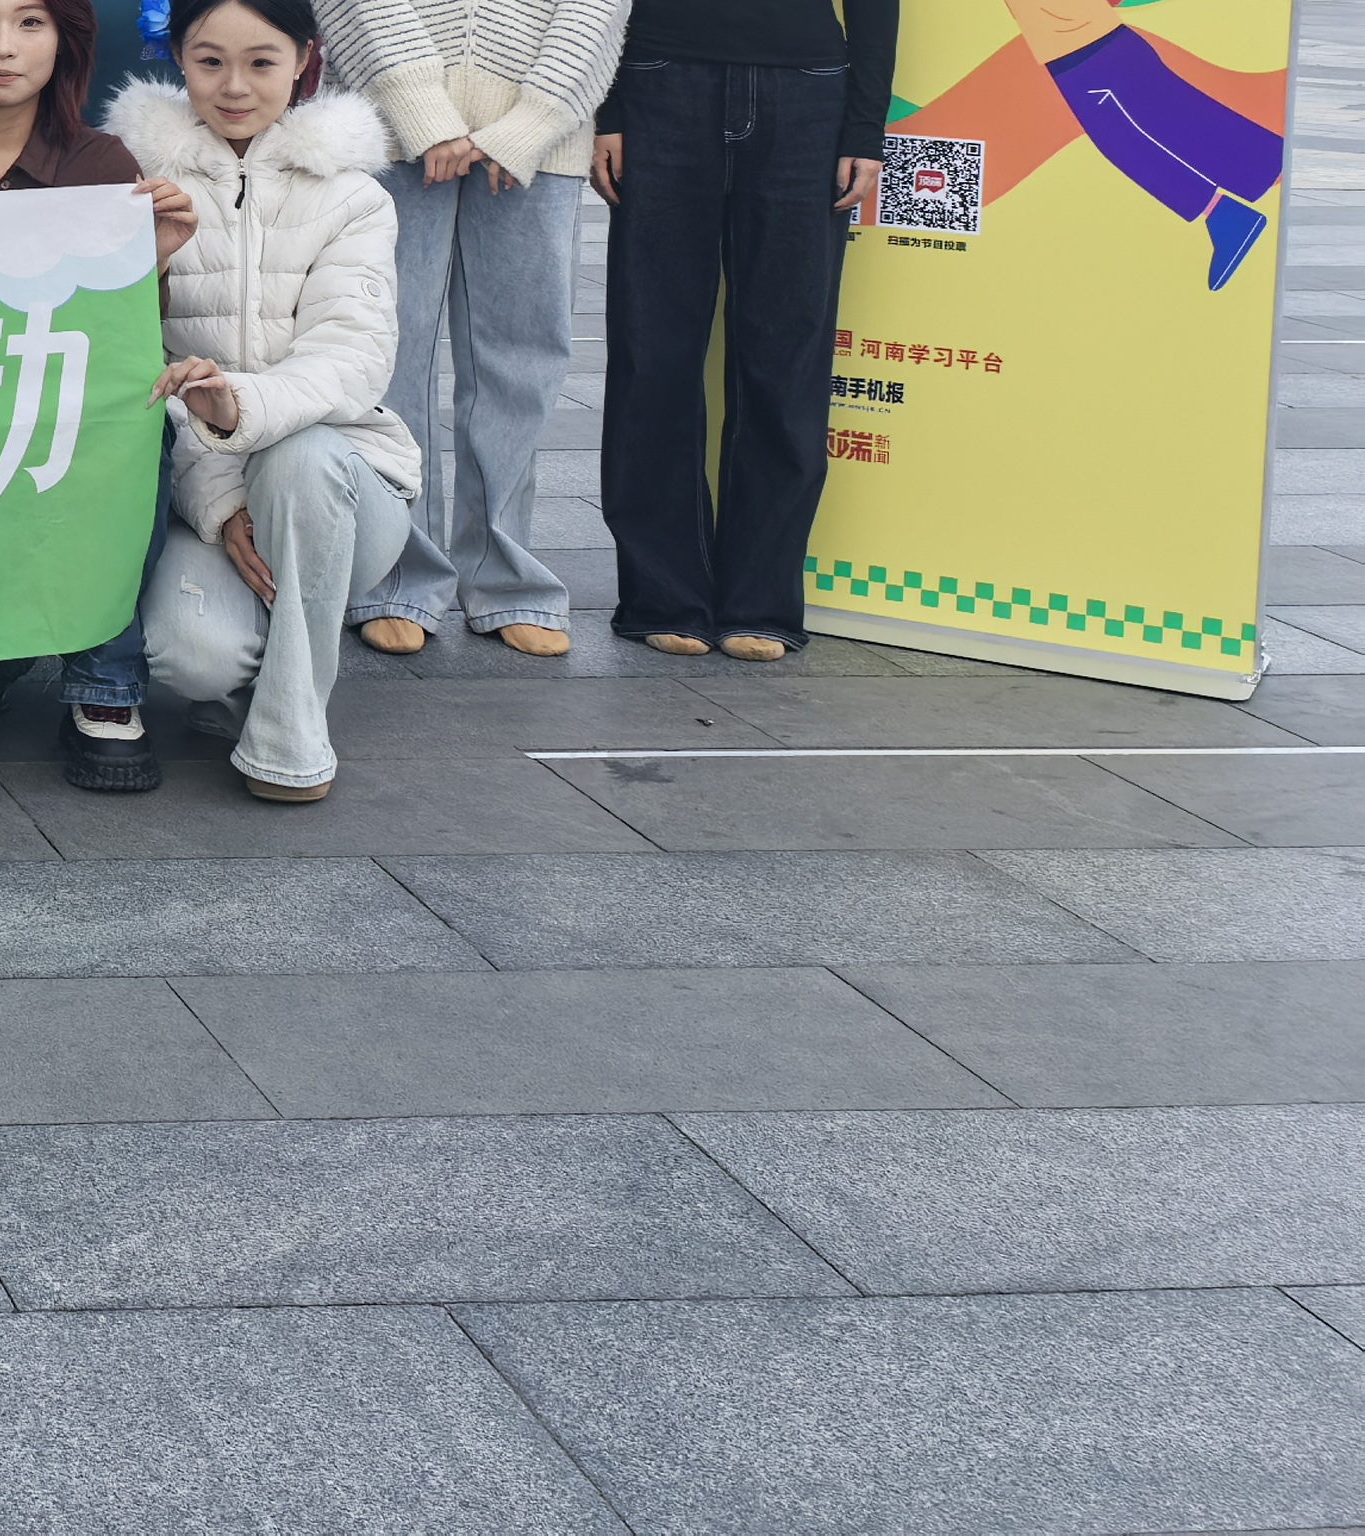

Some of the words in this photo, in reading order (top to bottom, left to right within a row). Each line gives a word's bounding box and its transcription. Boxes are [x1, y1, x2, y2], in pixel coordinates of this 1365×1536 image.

[860, 338, 1004, 374] 河南学习平台
[830, 374, 905, 405] 南手机报
